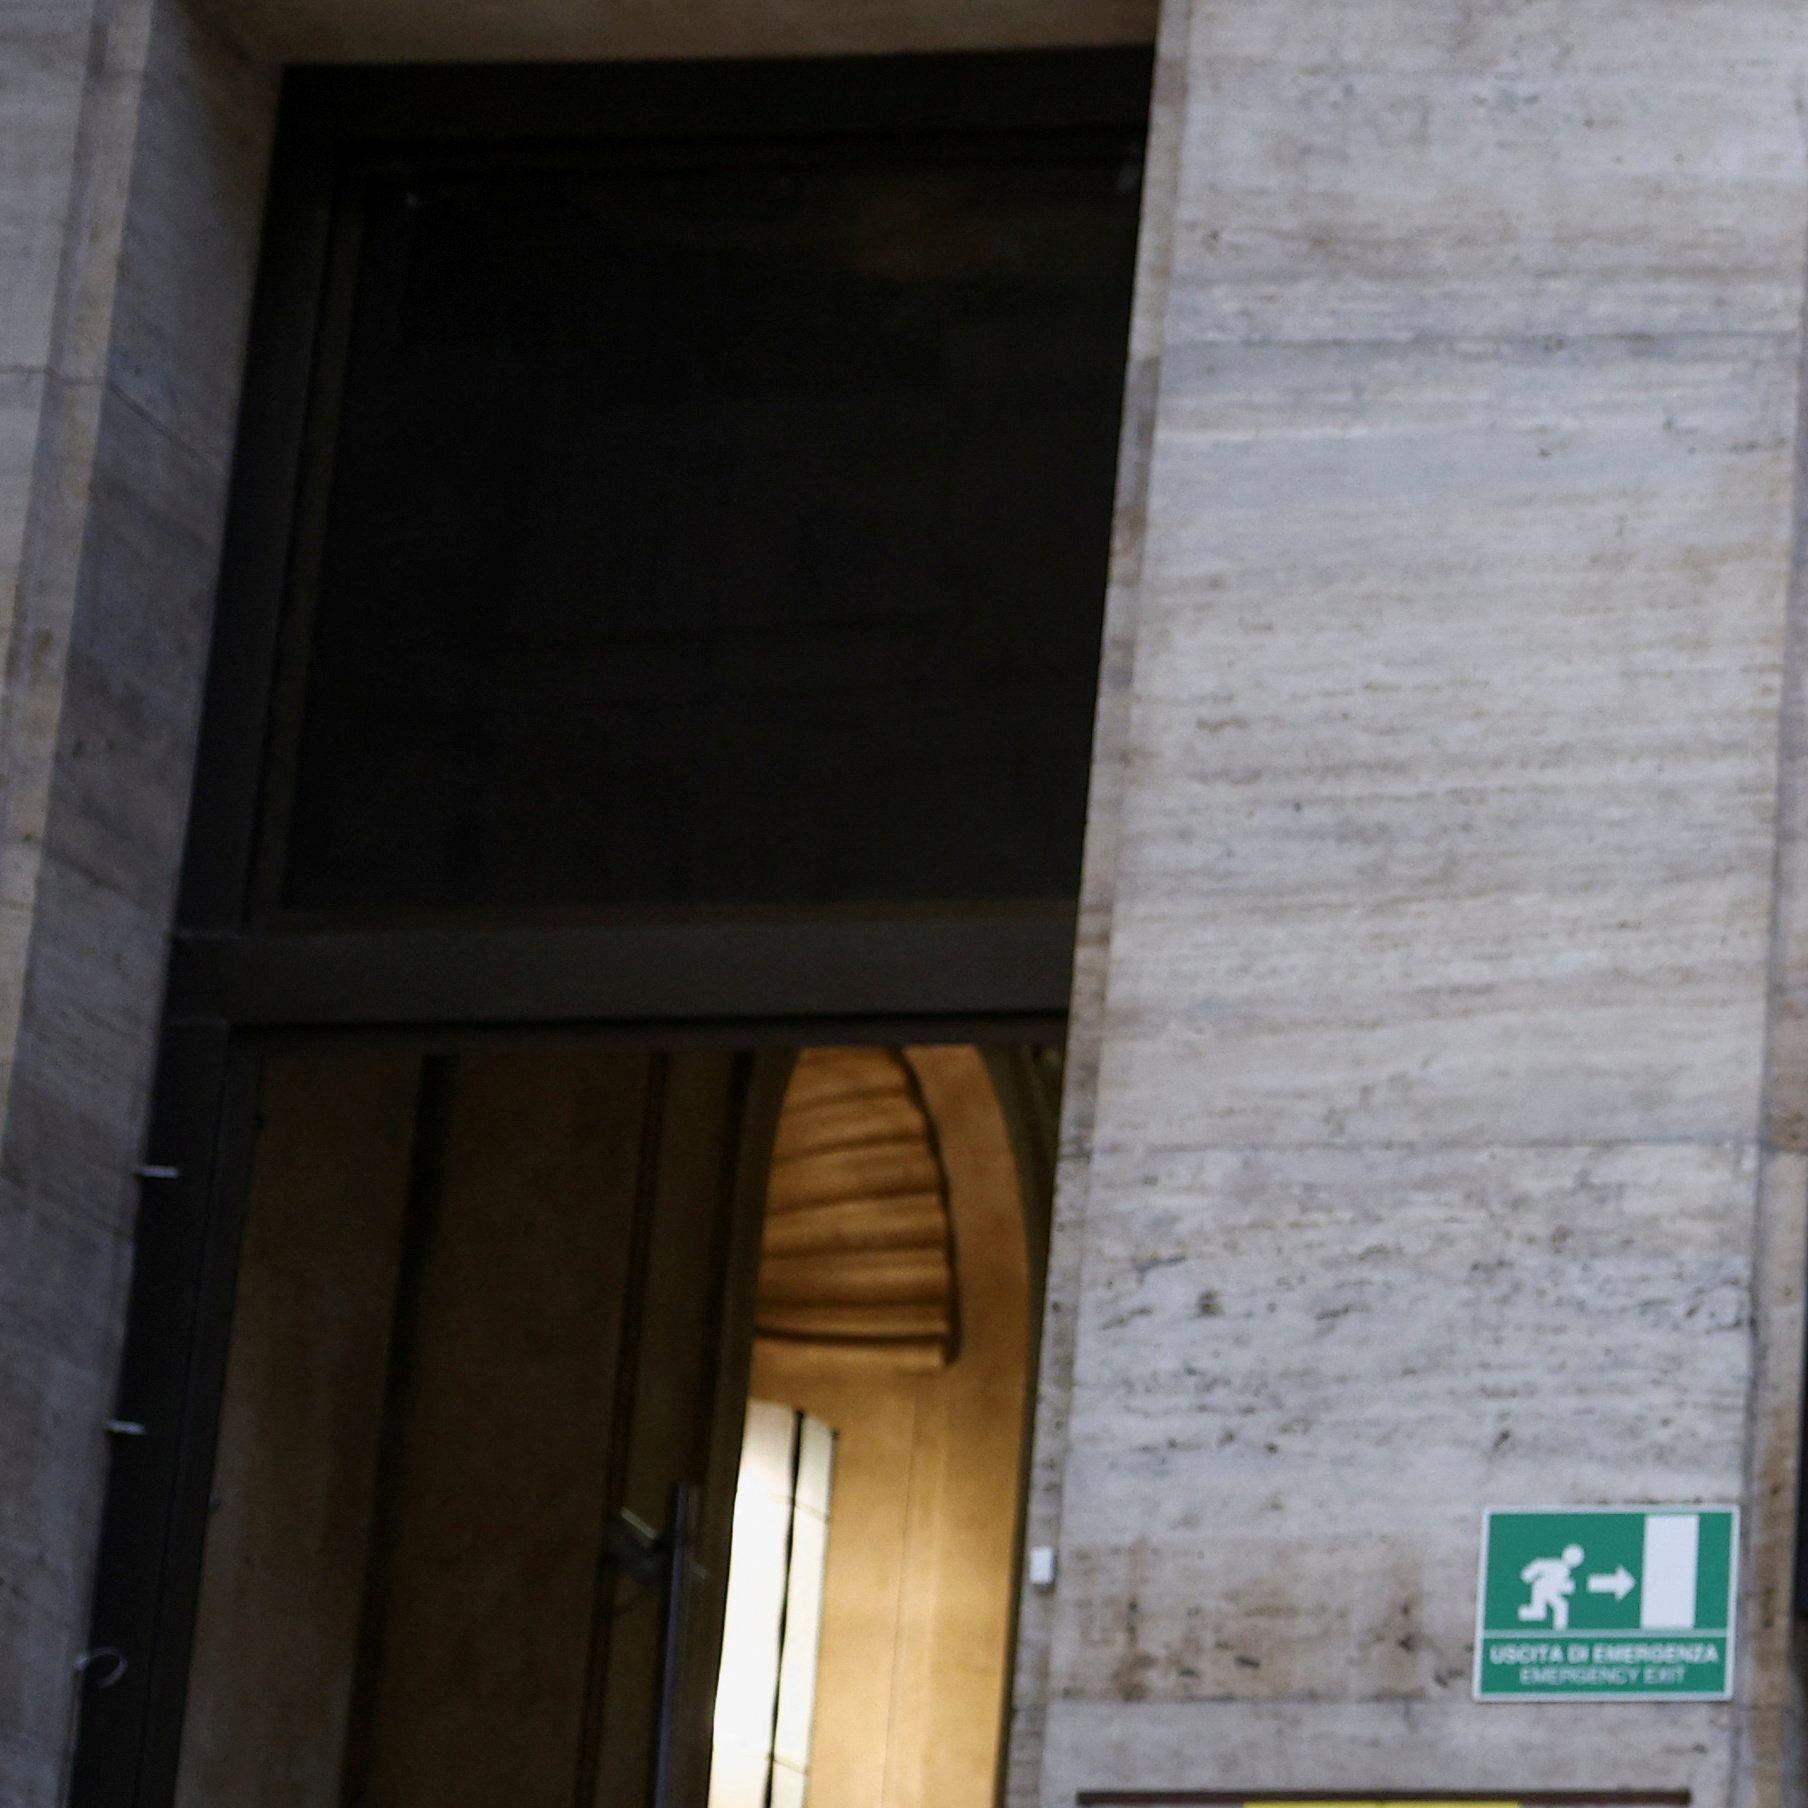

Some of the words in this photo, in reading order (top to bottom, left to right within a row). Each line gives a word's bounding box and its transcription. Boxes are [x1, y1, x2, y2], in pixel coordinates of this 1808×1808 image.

[1489, 1643, 1564, 1664] USCITA
[1568, 1643, 1590, 1664] DI
[1592, 1643, 1718, 1664] EMERGENZA
[1519, 1665, 1641, 1685] EMERGENCY
[1643, 1665, 1686, 1684] EXIT
